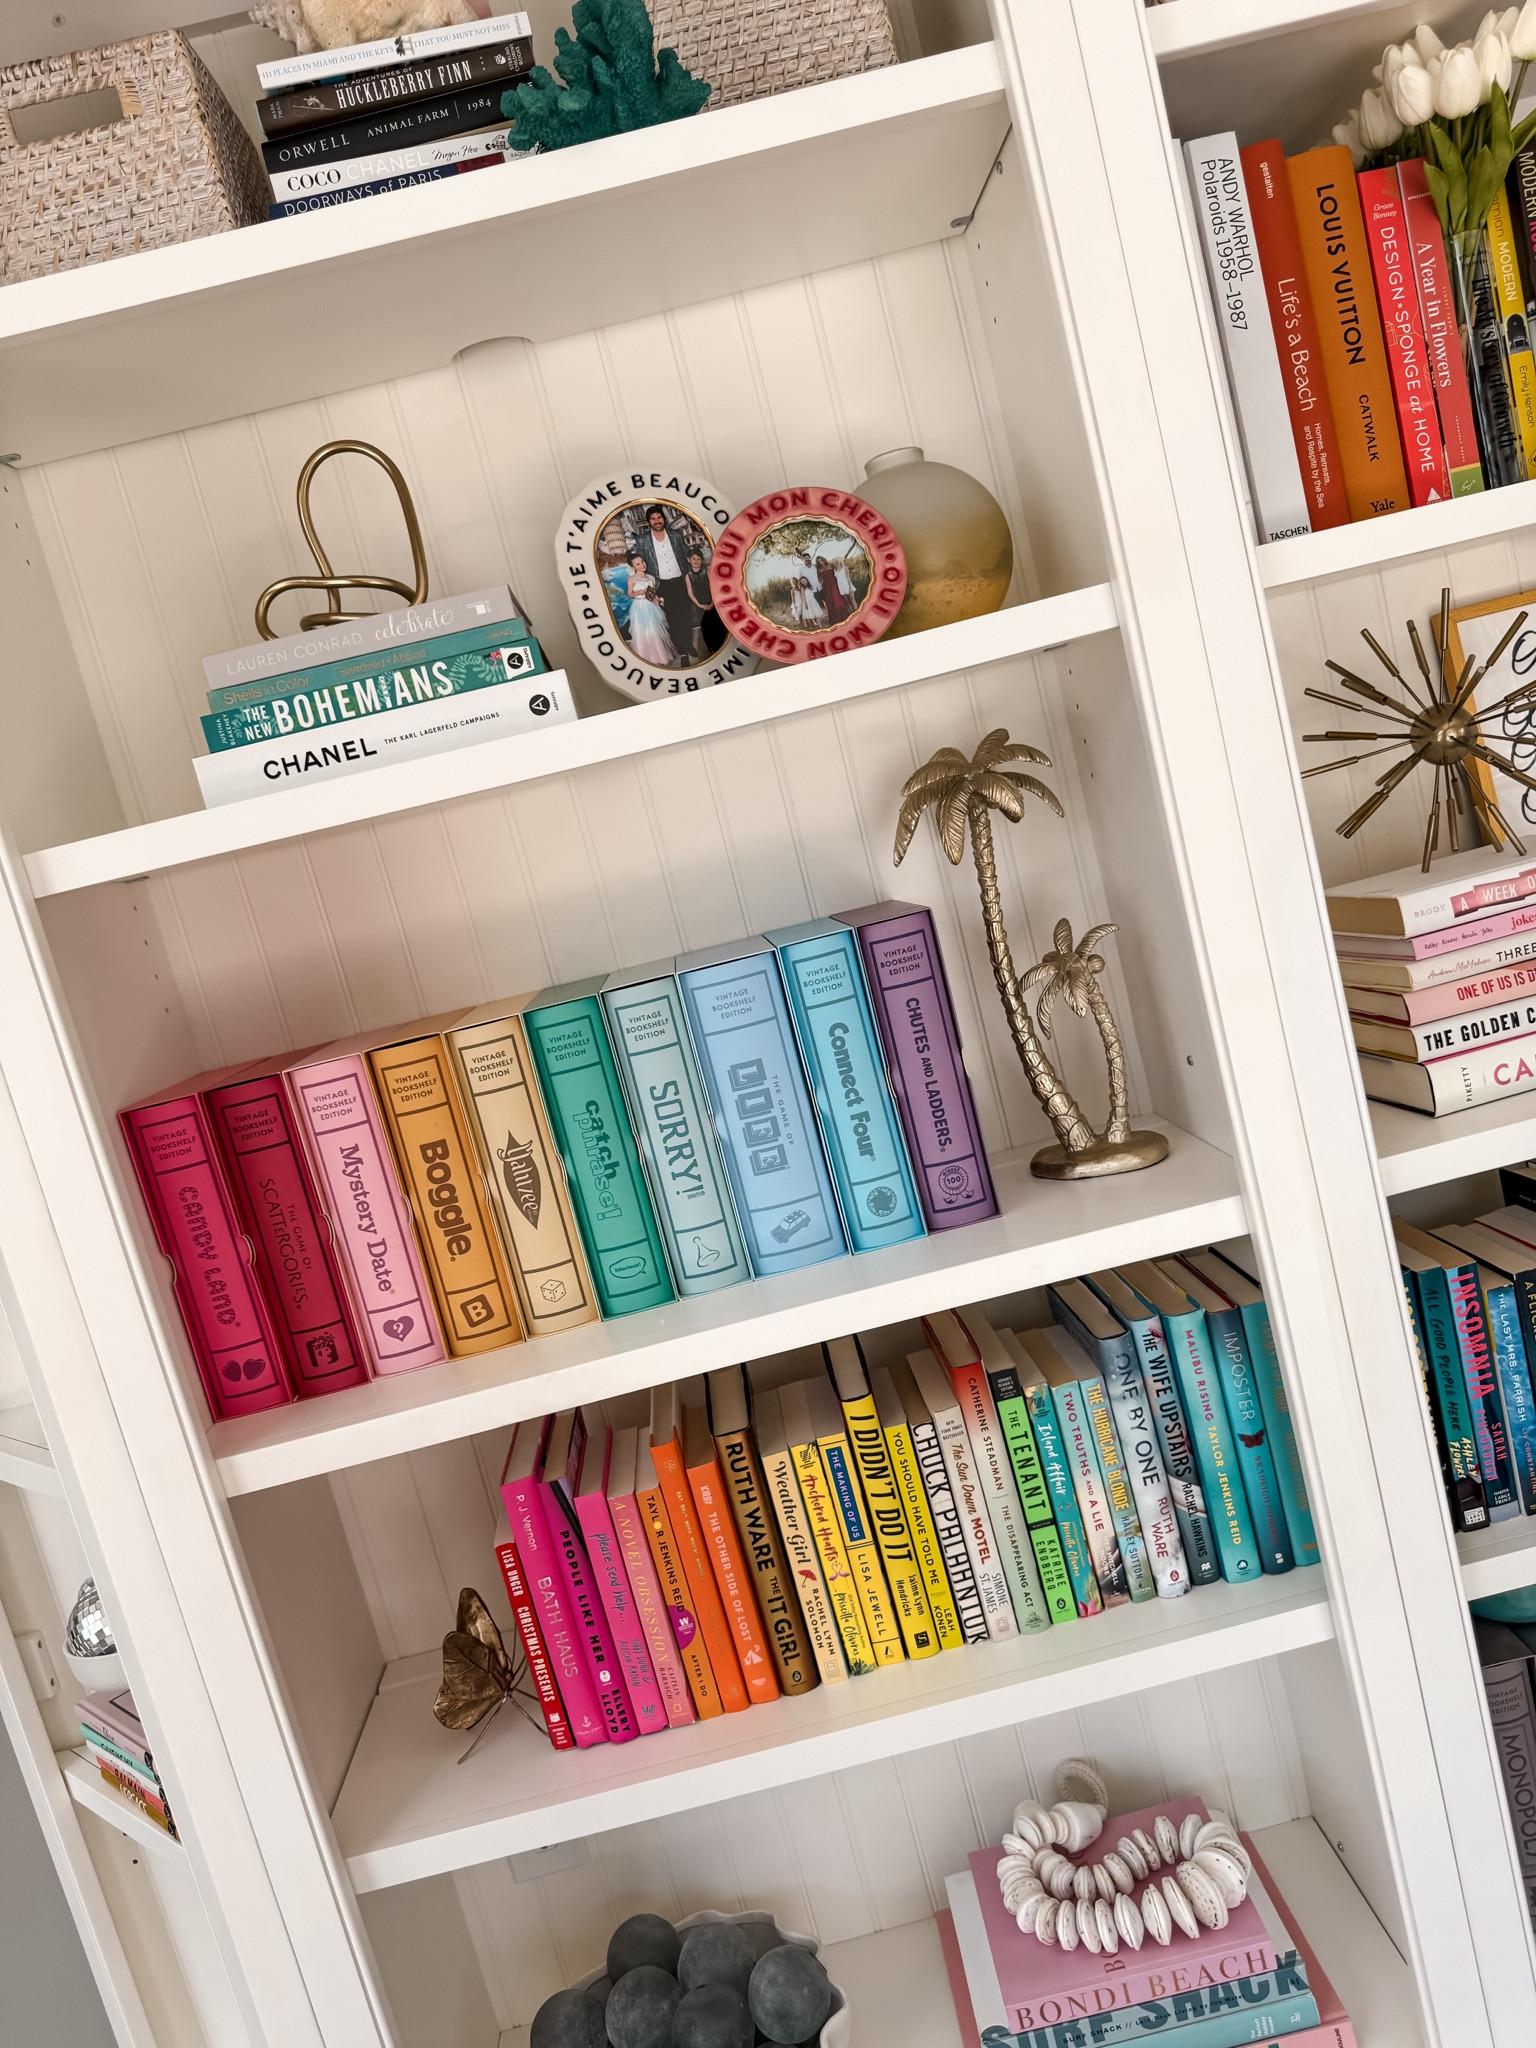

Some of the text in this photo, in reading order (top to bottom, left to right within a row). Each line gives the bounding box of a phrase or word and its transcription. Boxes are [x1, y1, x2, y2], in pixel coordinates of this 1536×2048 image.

[336, 60, 472, 109] HUCKLEBERRY FINN
[367, 98, 492, 137] ANIMAL FARM 1984
[279, 134, 350, 161] ORWELL
[284, 169, 442, 216] DOORWAYS of PARIS
[287, 169, 341, 191] COCO
[347, 152, 429, 179] CHANEL
[1260, 162, 1274, 199] gestalten
[1200, 160, 1227, 235] Polaroids
[1218, 159, 1254, 282] ANDY WARHOL
[1416, 243, 1433, 254] A
[1497, 241, 1518, 302] MODERN
[1316, 184, 1366, 365] LOUIS VUITTON
[1420, 256, 1437, 296] Year
[1427, 300, 1441, 318] in
[1278, 278, 1317, 411] Life's a Beach
[1430, 320, 1452, 388] Flowers
[1358, 394, 1380, 462] CATWALK
[566, 480, 622, 554] T'AIME
[1370, 499, 1395, 513] Yale
[716, 491, 896, 581] OUI MON CHERI
[1269, 525, 1309, 541] TASCHEN
[569, 563, 590, 589] JE
[719, 566, 901, 659] OUI MON CHERI
[226, 607, 454, 675] LAUREN CONRAD celebrate
[243, 705, 269, 723] THE
[271, 660, 454, 734] BOHEMIANS
[216, 718, 227, 745] JUSTINA
[244, 721, 272, 741] NEW
[264, 712, 500, 779] CHANEL THE KARL LAGERFELD CAMPAIGNS
[1414, 883, 1517, 918] BRODY A WEEK
[805, 963, 840, 978] VINTAGE
[880, 951, 924, 969] BOOKSHELF
[882, 944, 917, 959] VINTAGE
[888, 961, 921, 976] EDITION
[803, 971, 847, 988] BOOKSHELF
[811, 982, 843, 996] EDITION
[1456, 971, 1526, 1001] ONE OF US IS
[1423, 1011, 1520, 1051] THE GOLDEN
[470, 1057, 514, 1075] BOOKSHELF
[471, 1050, 507, 1065] VINTAGE
[478, 1068, 511, 1082] EDITION
[905, 997, 953, 1148] CHUTES AND LADDERS
[828, 1021, 876, 1160] Connect Four
[1461, 1066, 1472, 1102] PIKETTY
[772, 1074, 795, 1146] THE GAME OF
[585, 1100, 620, 1180] catch
[649, 1079, 704, 1196] SORRY!
[419, 1138, 473, 1257] Boggle
[496, 1139, 540, 1212] Yahtzee
[946, 1175, 961, 1185] 100
[259, 1177, 309, 1305] SCATTERGORIES
[287, 1203, 312, 1271] THE GAME OF
[339, 1144, 395, 1293] Mystery Date
[1525, 1281, 1534, 1290] A
[1450, 1272, 1495, 1400] INSOMNIA
[1498, 1293, 1527, 1422] THE LAST MRS. PARRISH
[1007, 1409, 1020, 1429] THE
[1491, 1422, 1507, 1461] SARAH
[1449, 1441, 1466, 1479] FLOWERS
[1461, 1437, 1478, 1476] ASHLEY
[1474, 1409, 1498, 1481] PINBOROUGH
[1010, 1430, 1046, 1510] TENANT
[774, 1460, 812, 1564] Weather Girl
[893, 1432, 940, 1585] YOU SHOULD HAVE TOLD ME
[1157, 1496, 1175, 1534] RUTH
[725, 1442, 800, 1667] RUTH WARE THE IT GIRL
[913, 1421, 990, 1644] CHUCK PALAHNIUK
[1150, 1521, 1169, 1558] WARE
[1036, 1540, 1057, 1591] ENGBERG
[1047, 1538, 1067, 1586] KATRINE
[560, 1530, 605, 1663] PEOPLE LIKE HER
[858, 1553, 886, 1636] LISA JEWELL
[991, 1572, 1008, 1606] SIMONE
[806, 1600, 824, 1649] SOLOMON
[812, 1588, 836, 1656] RACHEL LYNN
[933, 1605, 948, 1638] KONEN
[943, 1607, 955, 1632] LEAH
[601, 1693, 619, 1734] LLOYD
[612, 1688, 631, 1732] ELLERY
[1488, 1687, 1518, 1701] VINTAGE
[1491, 1703, 1520, 1715] EDITION
[1501, 1734, 1536, 1857] MONOPOLY
[1014, 1948, 1270, 2030] BONDI BEACH
[1063, 2031, 1086, 2044] SURF
[1090, 2024, 1122, 2037] SHACK
[1174, 2004, 1197, 2015] Living
[1224, 1993, 1245, 2003] Water
